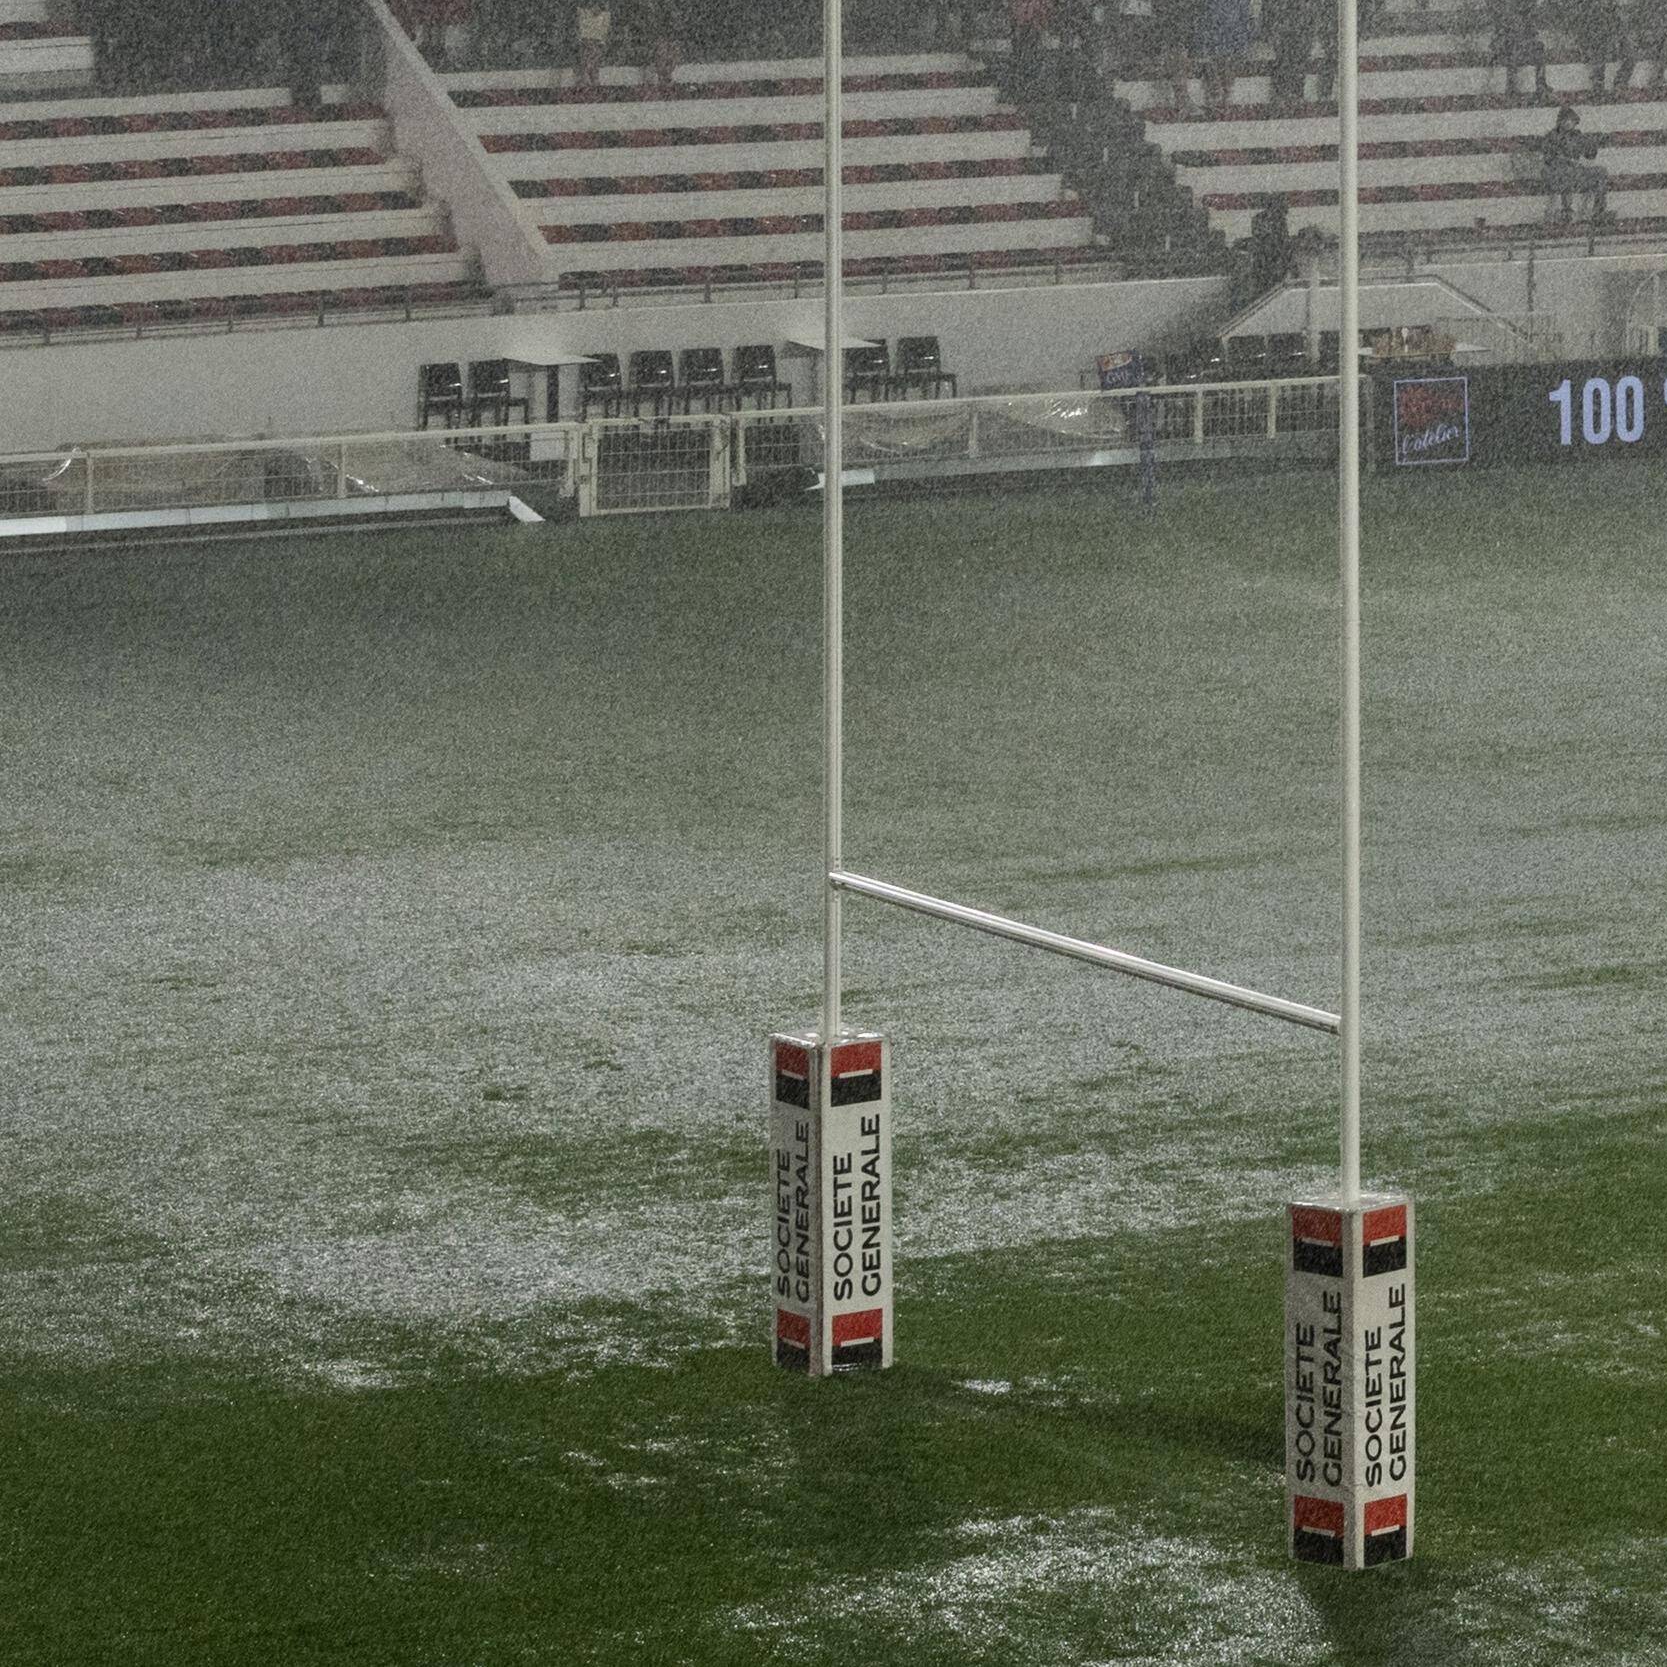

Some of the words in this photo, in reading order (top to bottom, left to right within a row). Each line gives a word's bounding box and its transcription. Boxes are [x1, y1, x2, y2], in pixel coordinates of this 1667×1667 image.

[1548, 375, 1644, 446] 100
[776, 1148, 791, 1299] SOCIETE
[795, 1120, 810, 1304] GENERALE
[833, 1151, 853, 1301] SOCIETE
[861, 1113, 882, 1297] GENERALE
[1296, 1322, 1316, 1483] SOCIETE
[1322, 1290, 1343, 1488] GENERALE
[1365, 1325, 1383, 1488] SOCIETE
[1388, 1282, 1407, 1482] GENERALE
